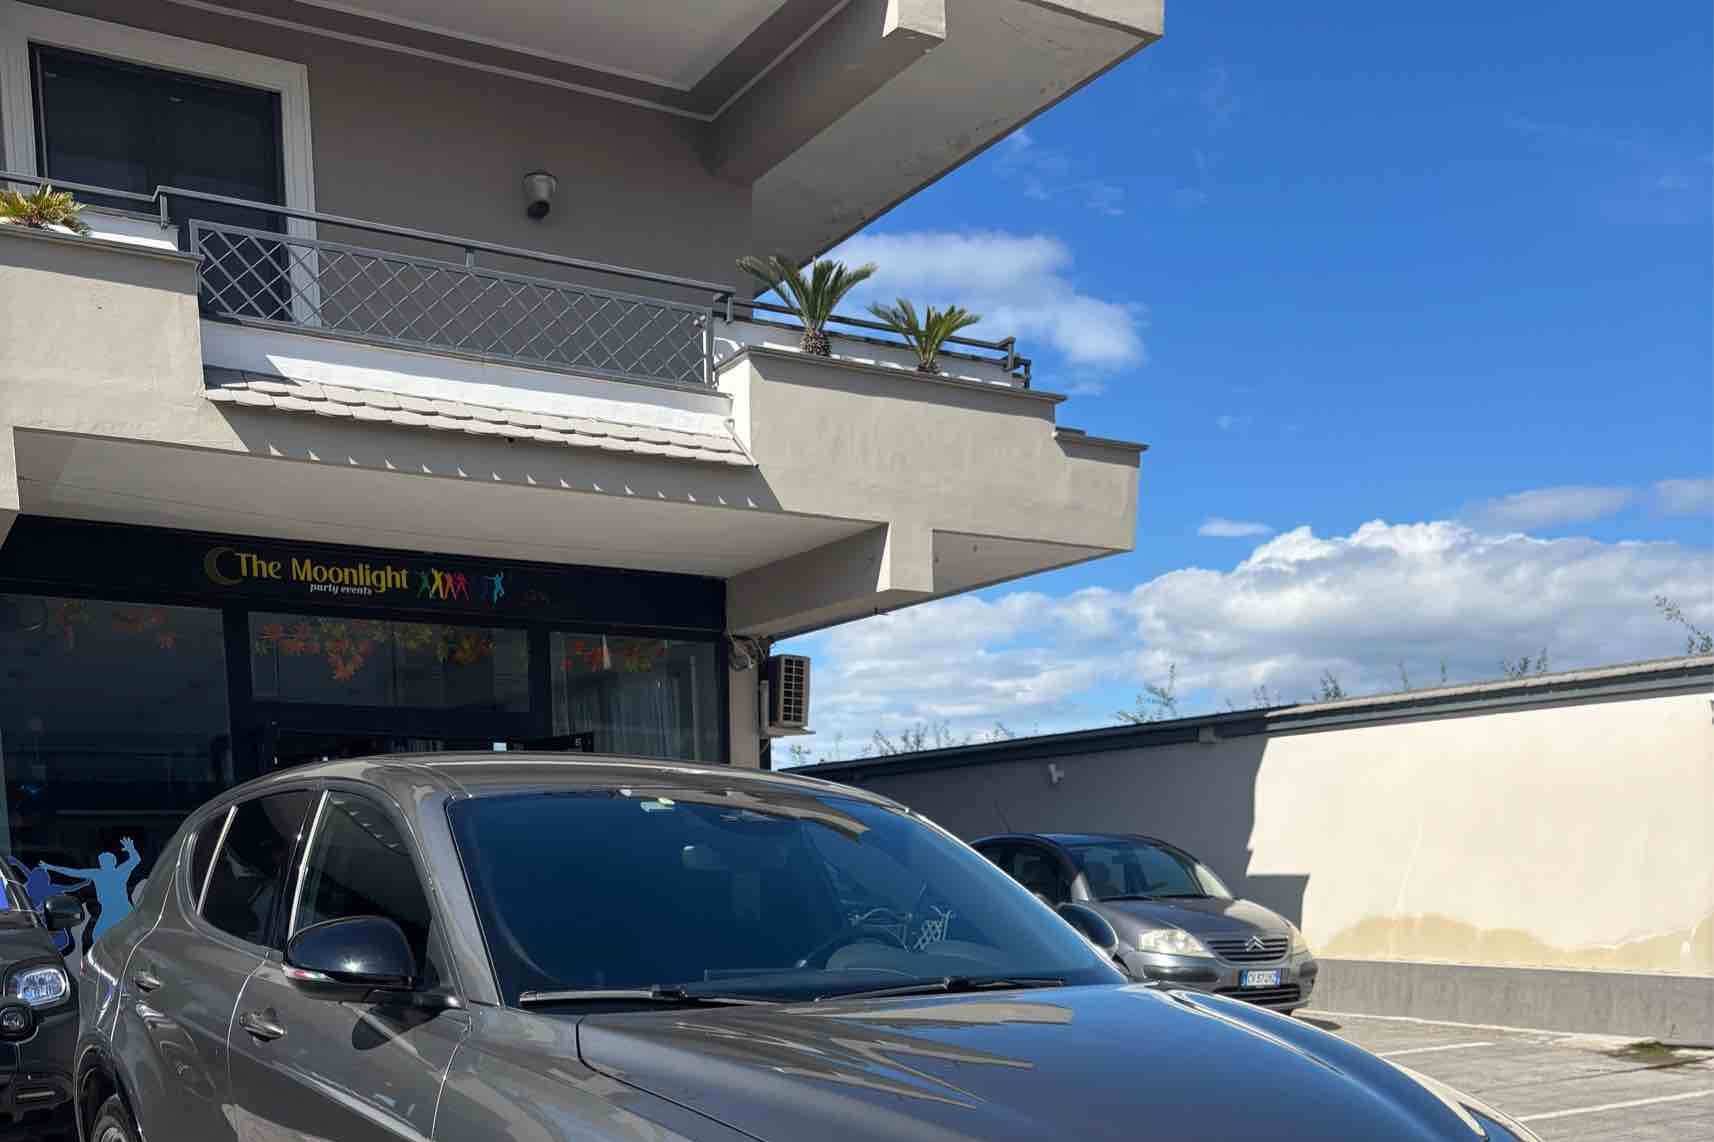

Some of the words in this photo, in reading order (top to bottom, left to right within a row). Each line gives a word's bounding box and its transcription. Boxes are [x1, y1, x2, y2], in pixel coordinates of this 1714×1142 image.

[235, 552, 282, 579] The
[291, 558, 408, 592] Moonlight
[310, 583, 339, 595] party
[340, 585, 373, 596] events
